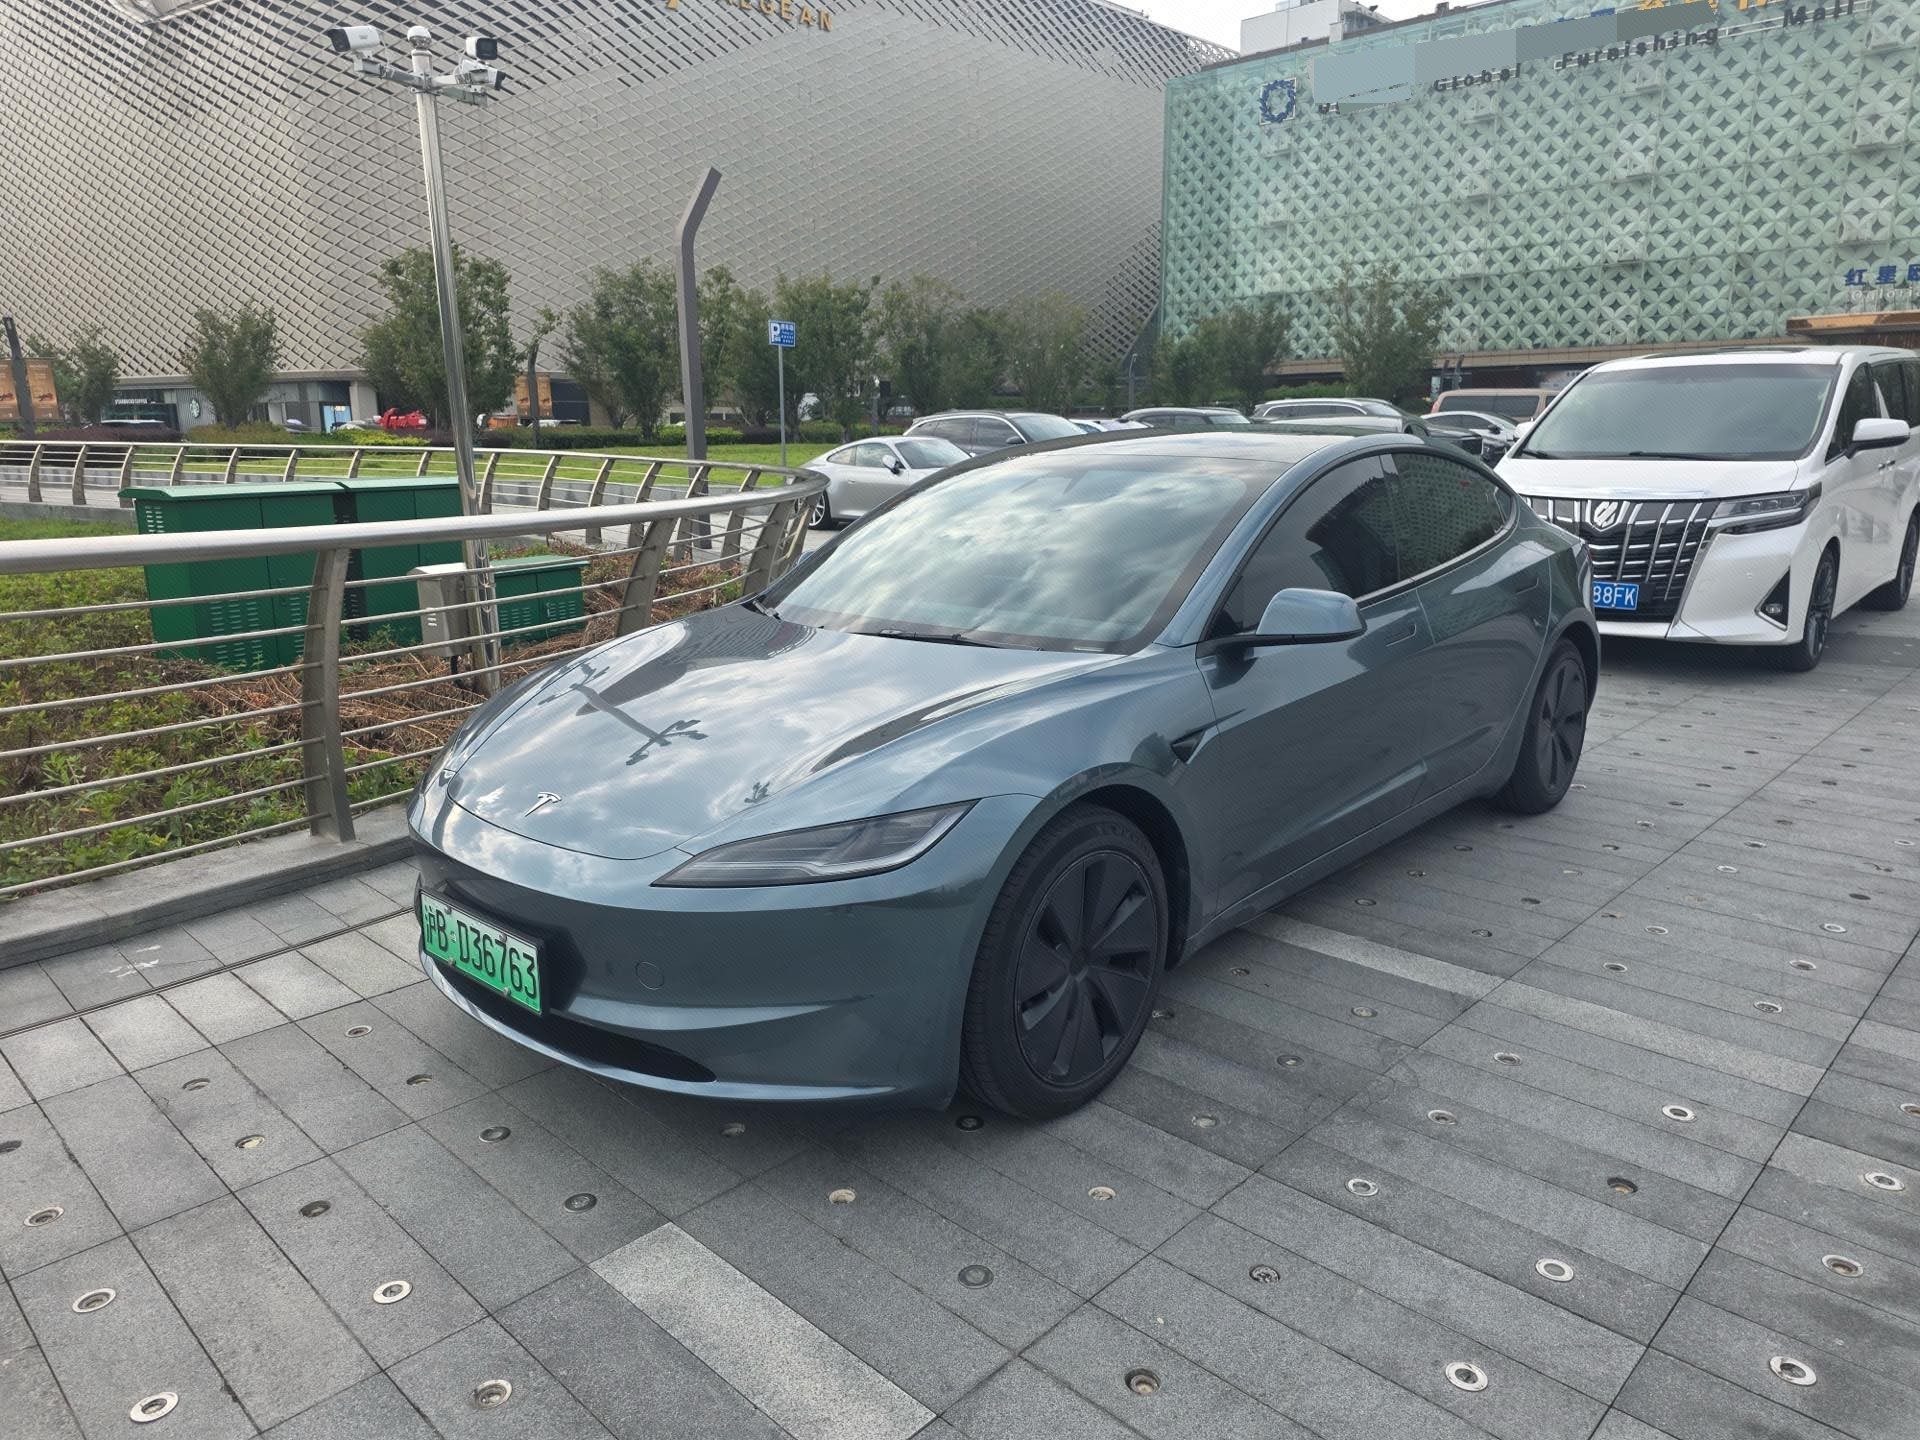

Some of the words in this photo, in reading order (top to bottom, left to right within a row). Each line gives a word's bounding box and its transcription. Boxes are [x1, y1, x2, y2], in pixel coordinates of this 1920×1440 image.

[726, 0, 833, 32] EGEAN
[1434, 63, 1521, 92] Global
[1562, 28, 1718, 68] Furnishing
[1783, 0, 1853, 28] Mall
[1593, 585, 1636, 606] 88FK
